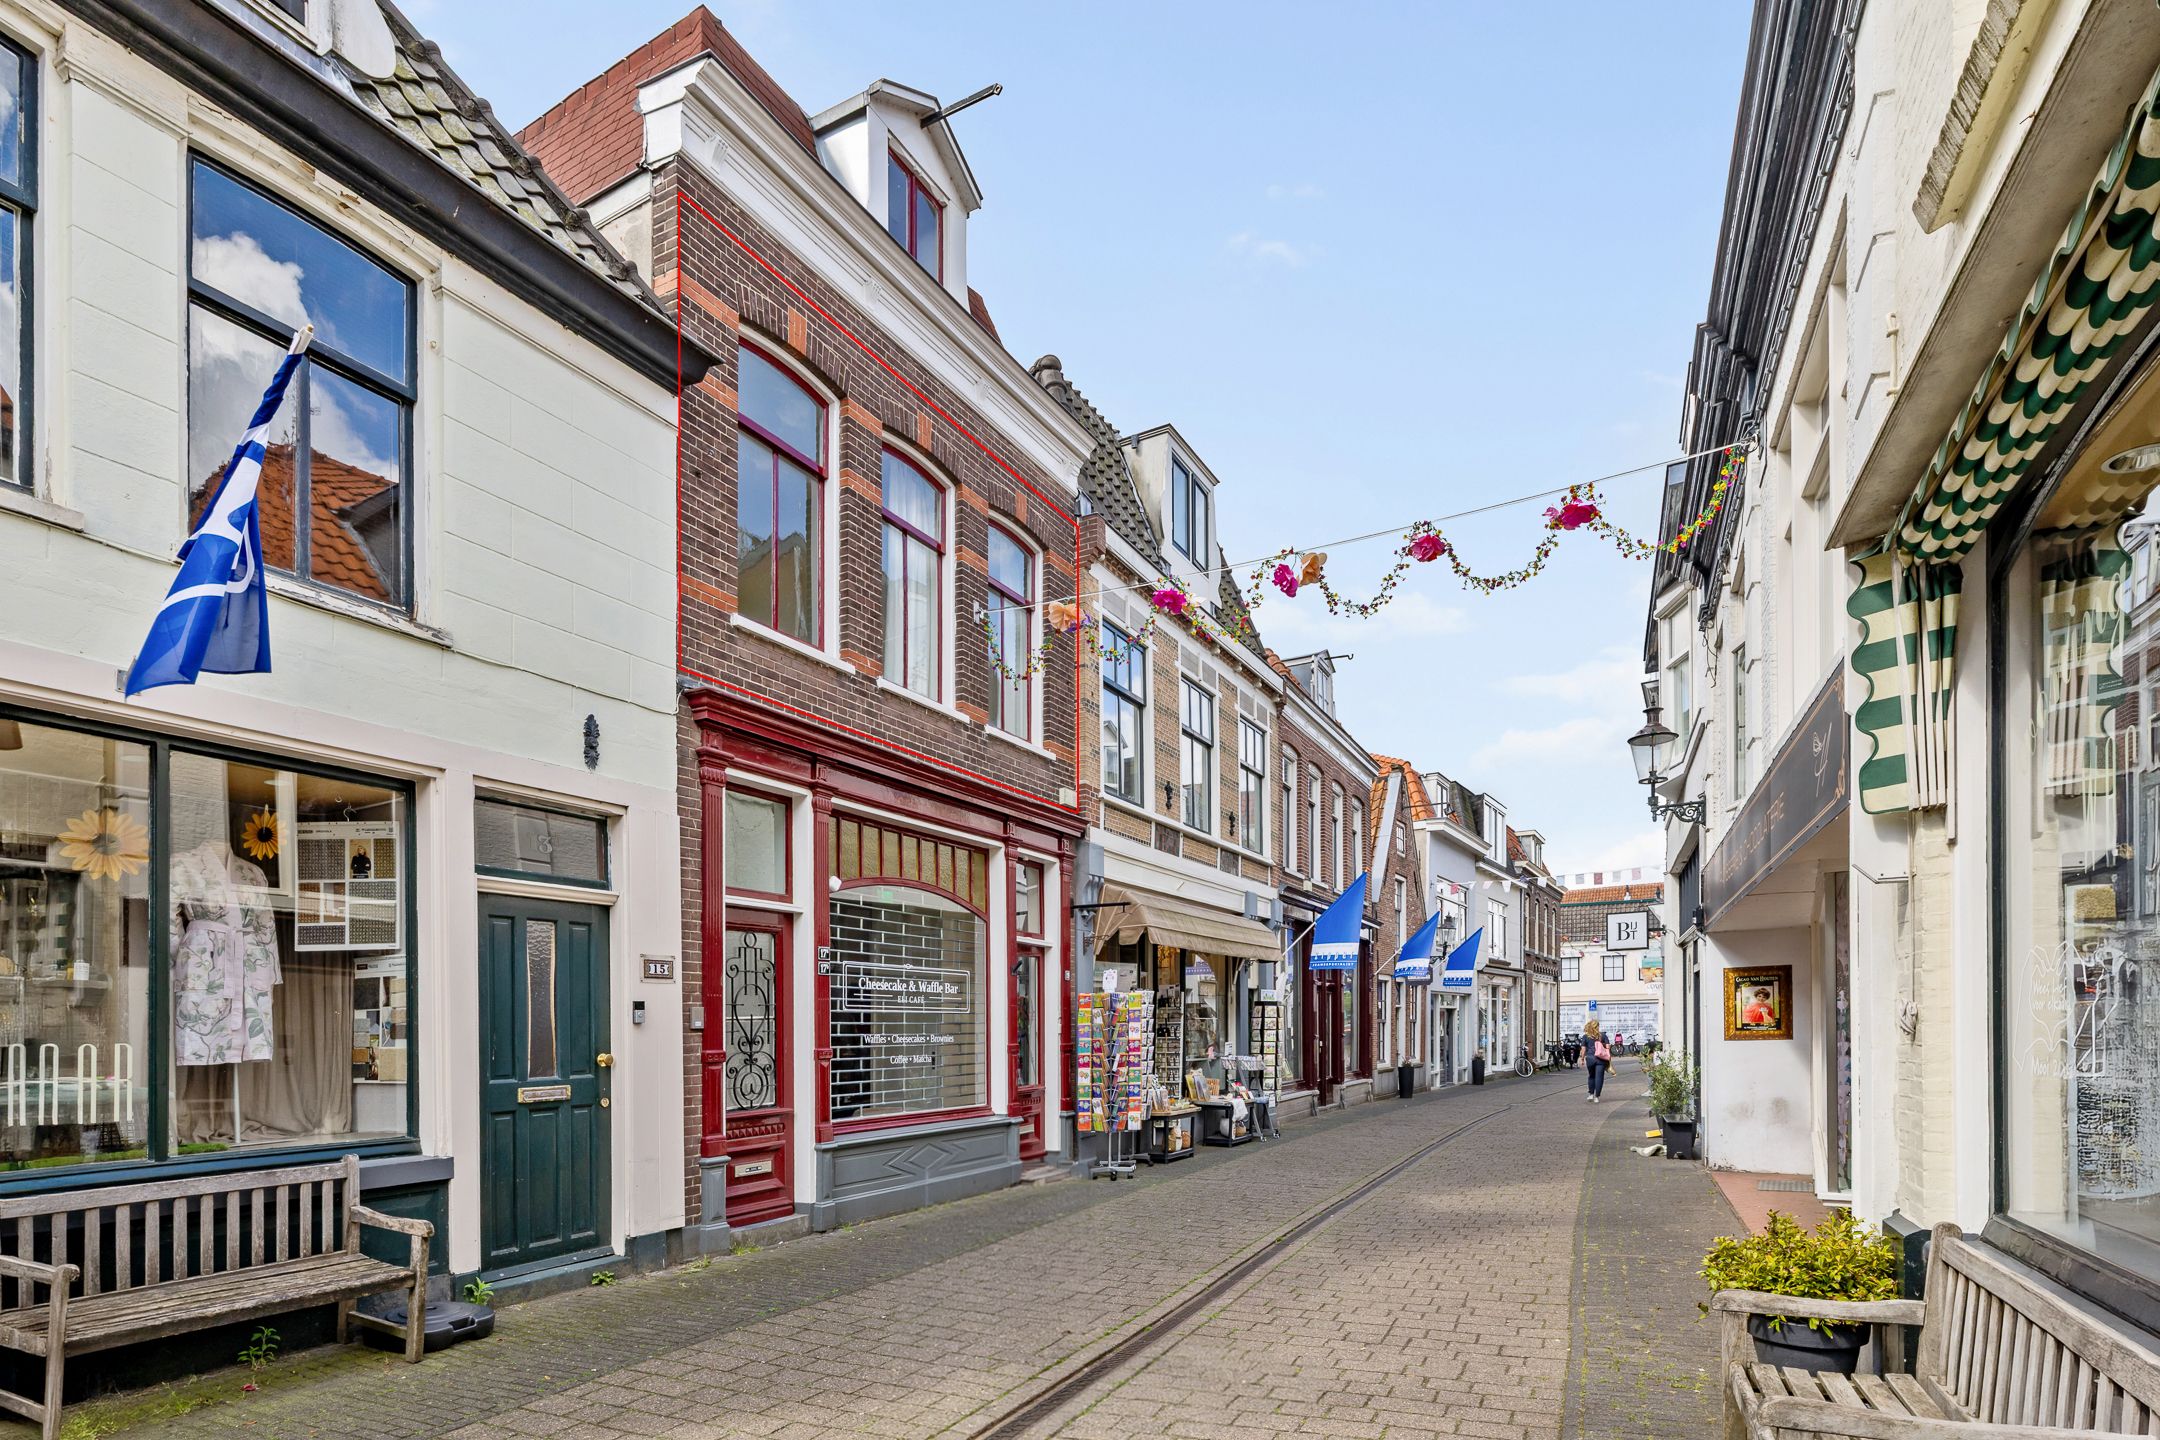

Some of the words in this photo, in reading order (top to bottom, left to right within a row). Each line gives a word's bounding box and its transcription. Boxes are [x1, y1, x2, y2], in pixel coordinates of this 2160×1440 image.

[653, 964, 666, 974] 15
[859, 977, 907, 991] Cheesecake
[909, 980, 917, 992] &
[918, 981, 943, 993] Waffle
[945, 982, 959, 994] Bar
[909, 994, 925, 1004] CAFÉ
[863, 1034, 886, 1043] Waffles
[891, 1034, 926, 1043] Cheesecakes
[930, 1034, 955, 1044] Brownies
[890, 1055, 908, 1064] Coffee
